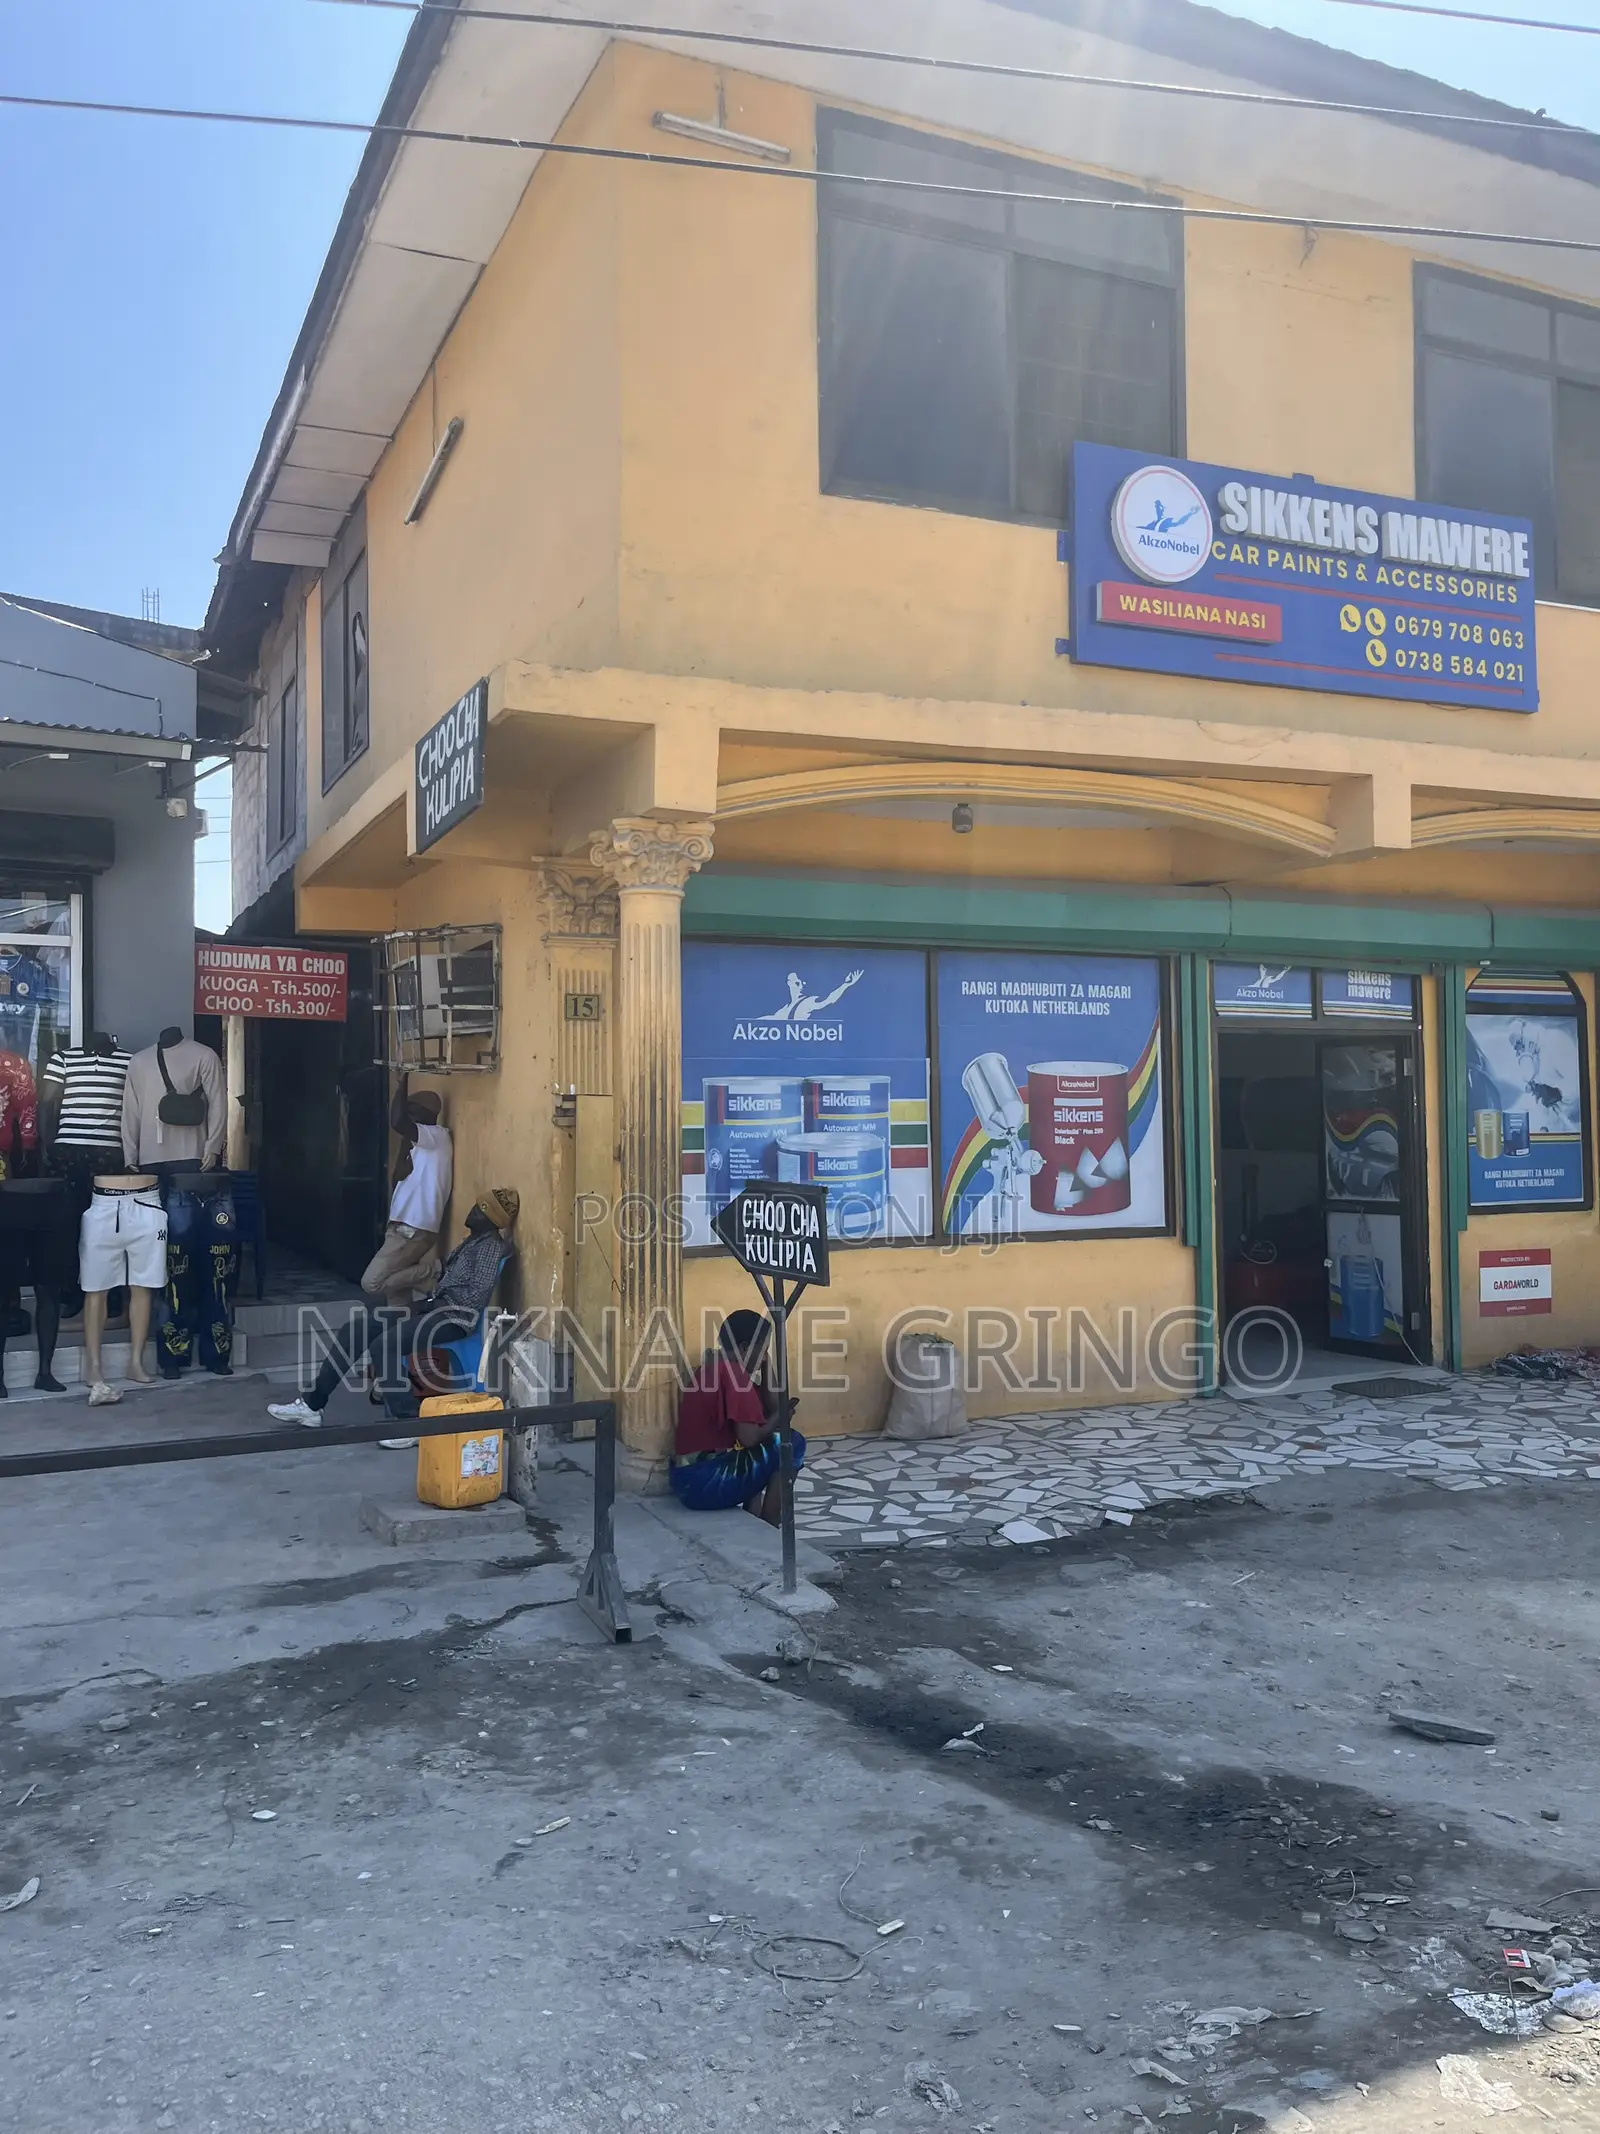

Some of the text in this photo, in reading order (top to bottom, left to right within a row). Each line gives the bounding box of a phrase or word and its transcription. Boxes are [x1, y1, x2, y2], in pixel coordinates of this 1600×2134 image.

[1217, 481, 1530, 579] SIKKENS MAWERE
[1138, 534, 1200, 556] AkzoNobel
[1211, 540, 1518, 605] CAR PAINTS & ACCESSORIES
[1118, 593, 1267, 631] WASILIANA NASI
[1394, 614, 1525, 651] 0679 708 063
[1394, 648, 1524, 683] 0738 584 021
[418, 687, 480, 788] CHOO CHA
[426, 746, 475, 836] KULIPIA
[198, 950, 345, 975] HUDUMA YA CHOO
[199, 975, 259, 993] KUOGA
[272, 980, 342, 998] Tsh.500/-
[961, 981, 1132, 999] RANGI MADHUBUTI ZA MAGARI
[1236, 987, 1284, 999] Akzo Nobel
[1347, 985, 1392, 1000] mawere
[204, 995, 254, 1012] CHOO
[265, 999, 336, 1016] Tsh.300/-
[571, 996, 595, 1018] 15
[985, 999, 1110, 1016] KUTOKA NETHERLANDS
[732, 1023, 843, 1042] Akzo Nobel
[728, 1096, 782, 1112] sikkens
[822, 1092, 871, 1107] sikkens
[1053, 1107, 1104, 1122] sikkens
[817, 1159, 859, 1171] sikkens
[742, 1198, 820, 1239] CHOO CHA
[745, 1233, 817, 1273] KULIPIA
[1493, 1278, 1539, 1290] GARDAWORLD
